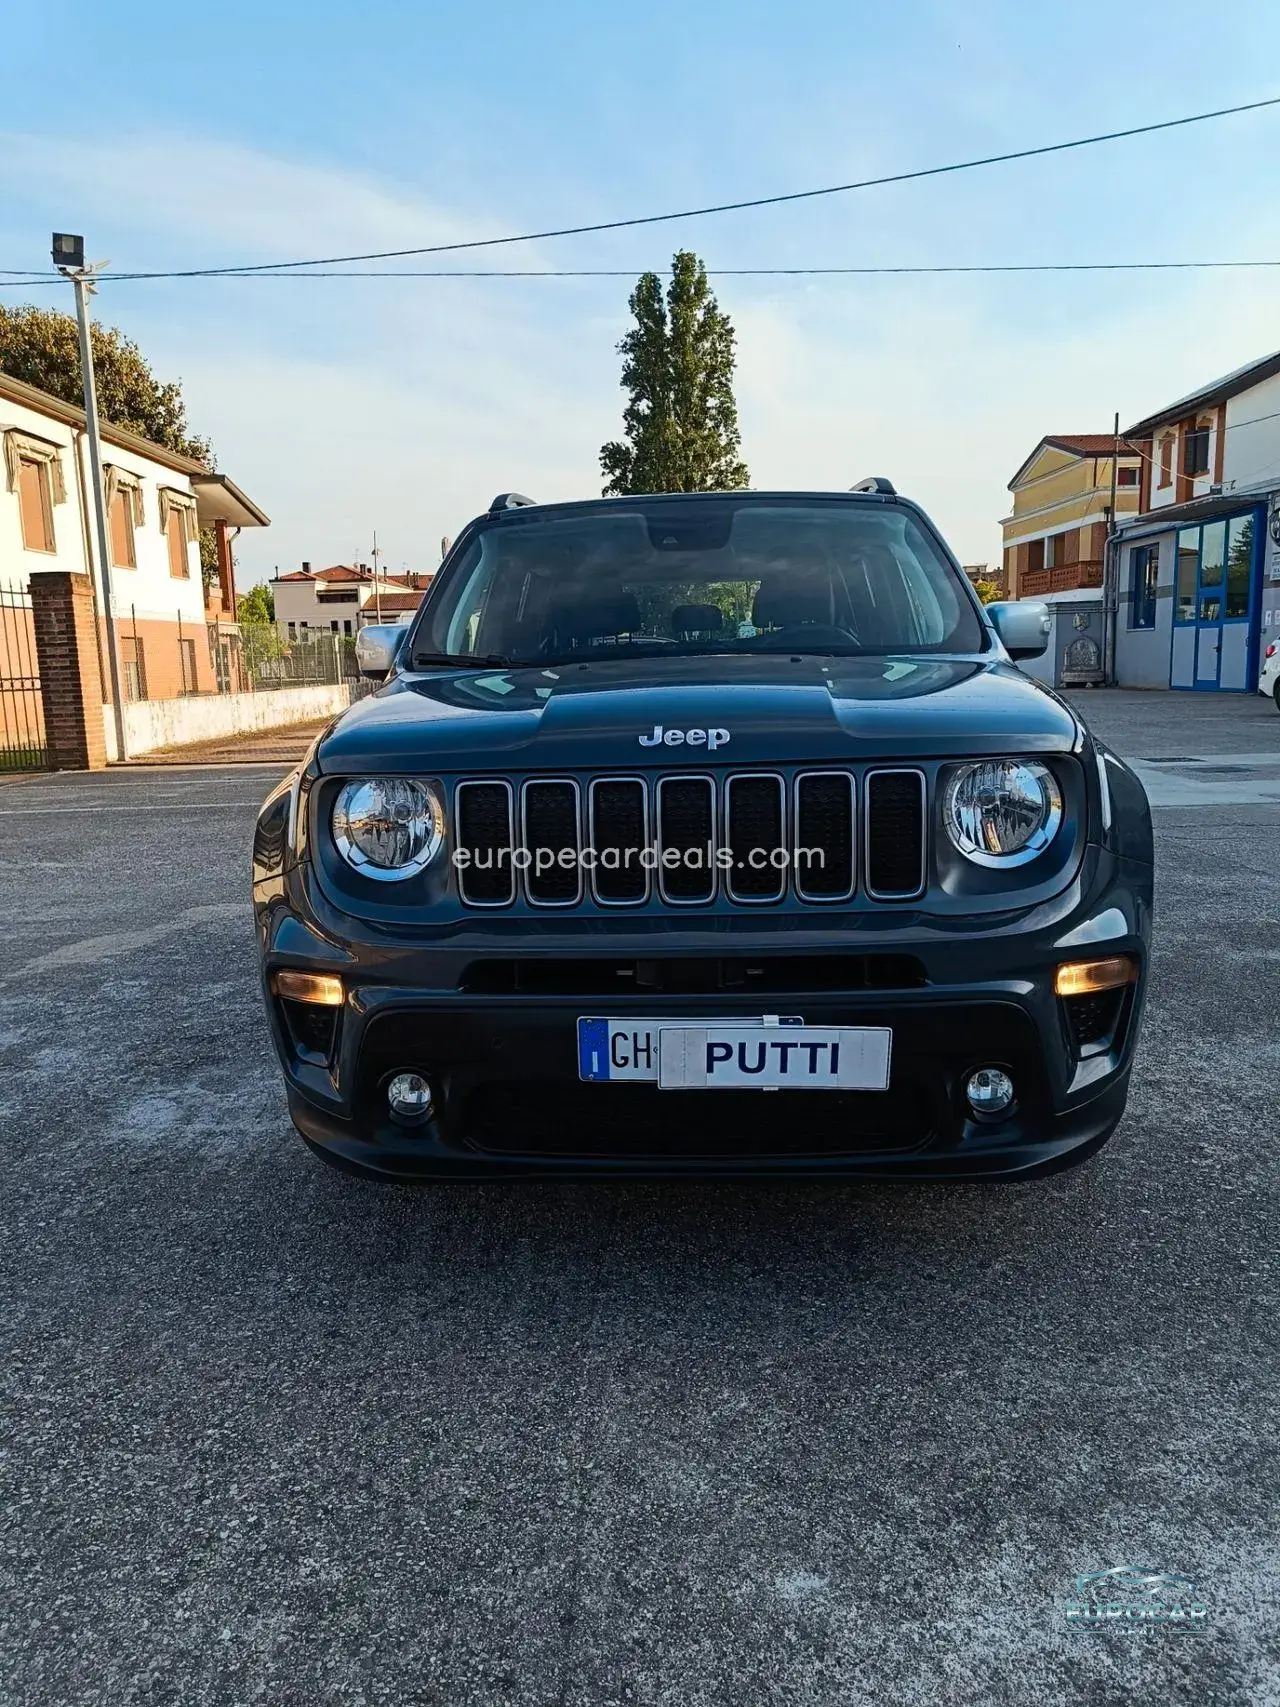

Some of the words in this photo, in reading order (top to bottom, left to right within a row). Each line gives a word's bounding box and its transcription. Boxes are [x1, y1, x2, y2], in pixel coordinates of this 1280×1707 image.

[638, 725, 731, 750] Jeep
[610, 1032, 651, 1069] GH
[706, 1042, 839, 1074] PUTTI
